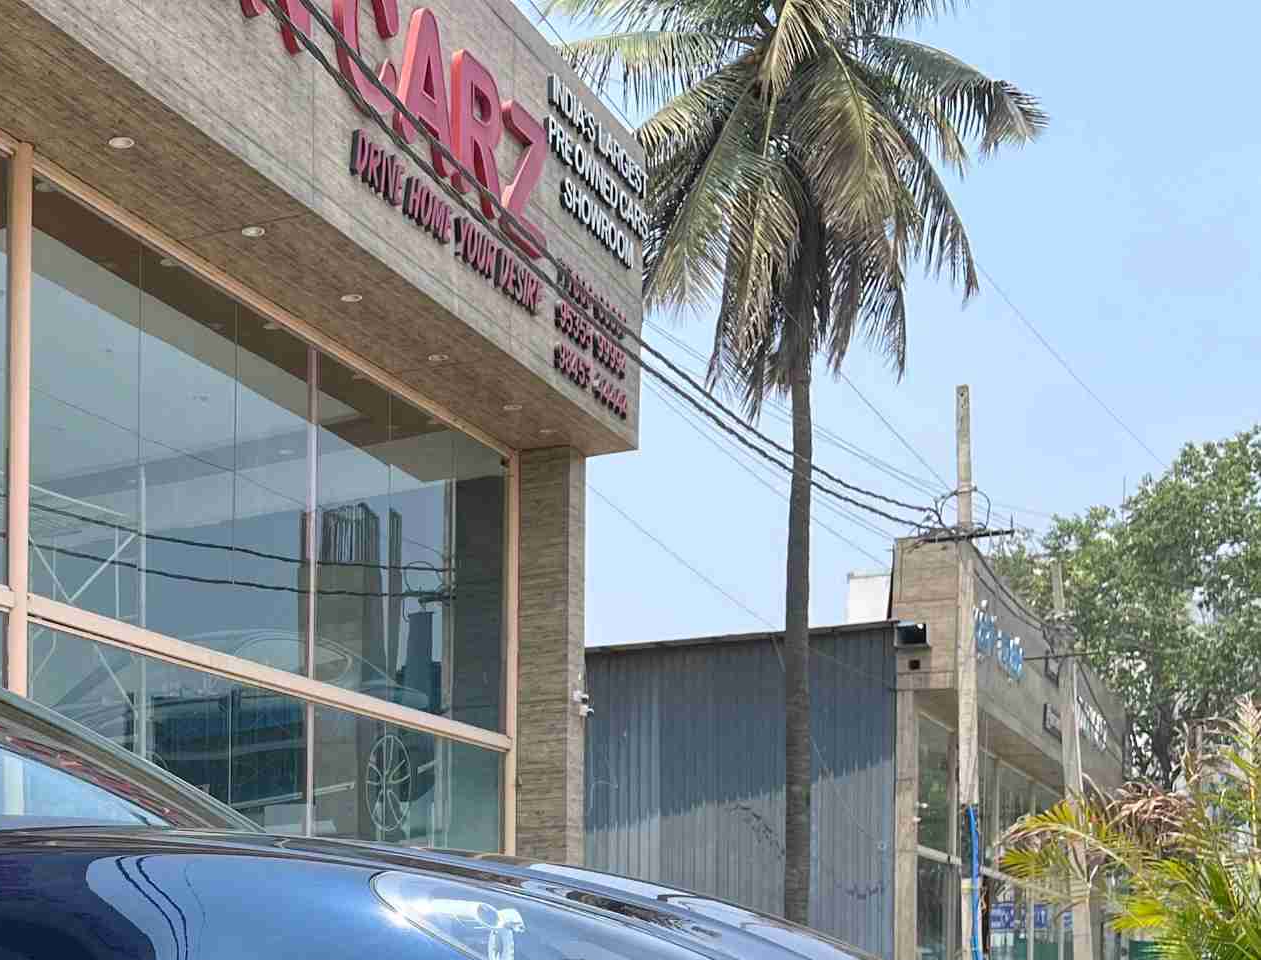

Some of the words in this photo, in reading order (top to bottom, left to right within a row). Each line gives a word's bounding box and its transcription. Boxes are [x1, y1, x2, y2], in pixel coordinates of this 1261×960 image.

[332, 0, 546, 259] CARZ
[546, 114, 574, 166] PRE
[573, 142, 618, 210] OWNED
[617, 189, 650, 241] CARS
[548, 73, 596, 142] INDIA'S
[596, 120, 649, 198] LARGEST
[349, 127, 406, 208] DRIVE
[402, 175, 452, 245] HOME
[452, 215, 498, 280] YOUR
[493, 248, 546, 316] DESIRE
[562, 177, 635, 270] SHOWROOM
